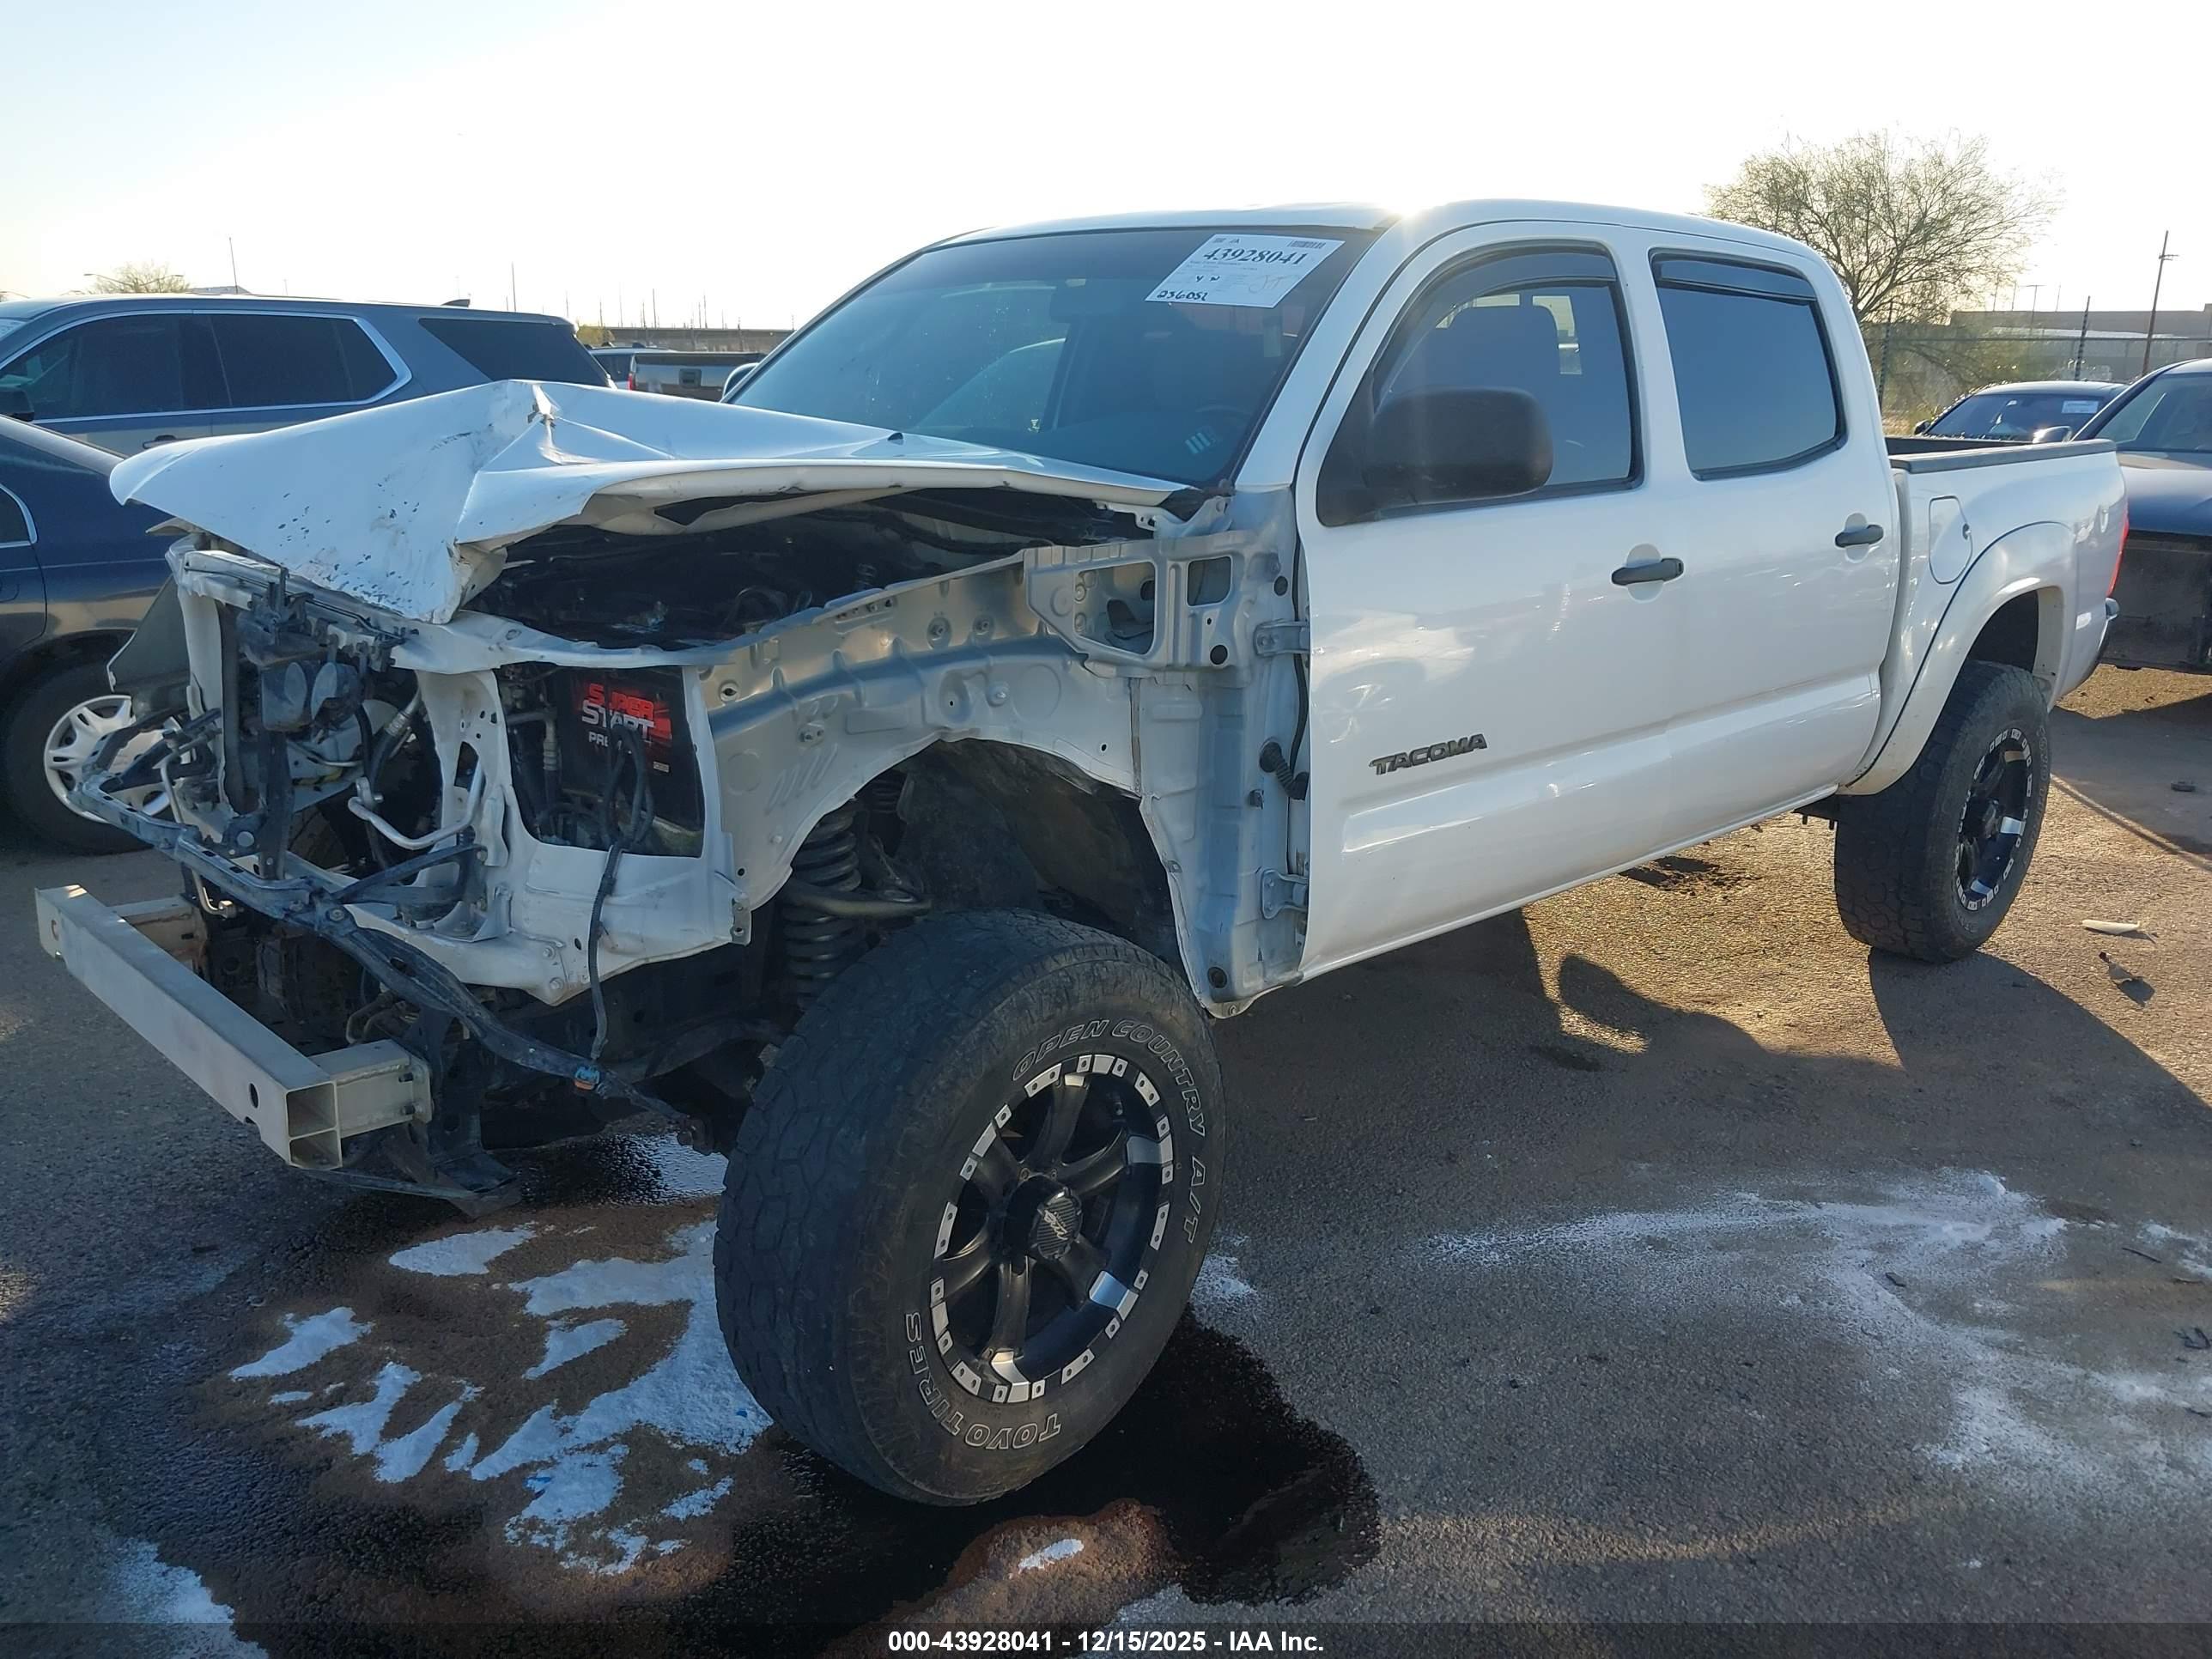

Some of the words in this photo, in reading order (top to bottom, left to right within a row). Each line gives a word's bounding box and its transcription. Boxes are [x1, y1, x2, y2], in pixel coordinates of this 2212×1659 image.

[1203, 246, 1310, 265] 43928041
[1368, 732, 1488, 775] TACOMA
[1012, 1019, 1110, 1082] OPEN
[1111, 1019, 1206, 1137] COUNTRY
[1182, 1155, 1206, 1244] A/T
[905, 1311, 964, 1437] TIRES
[963, 1413, 1062, 1450] TOYO
